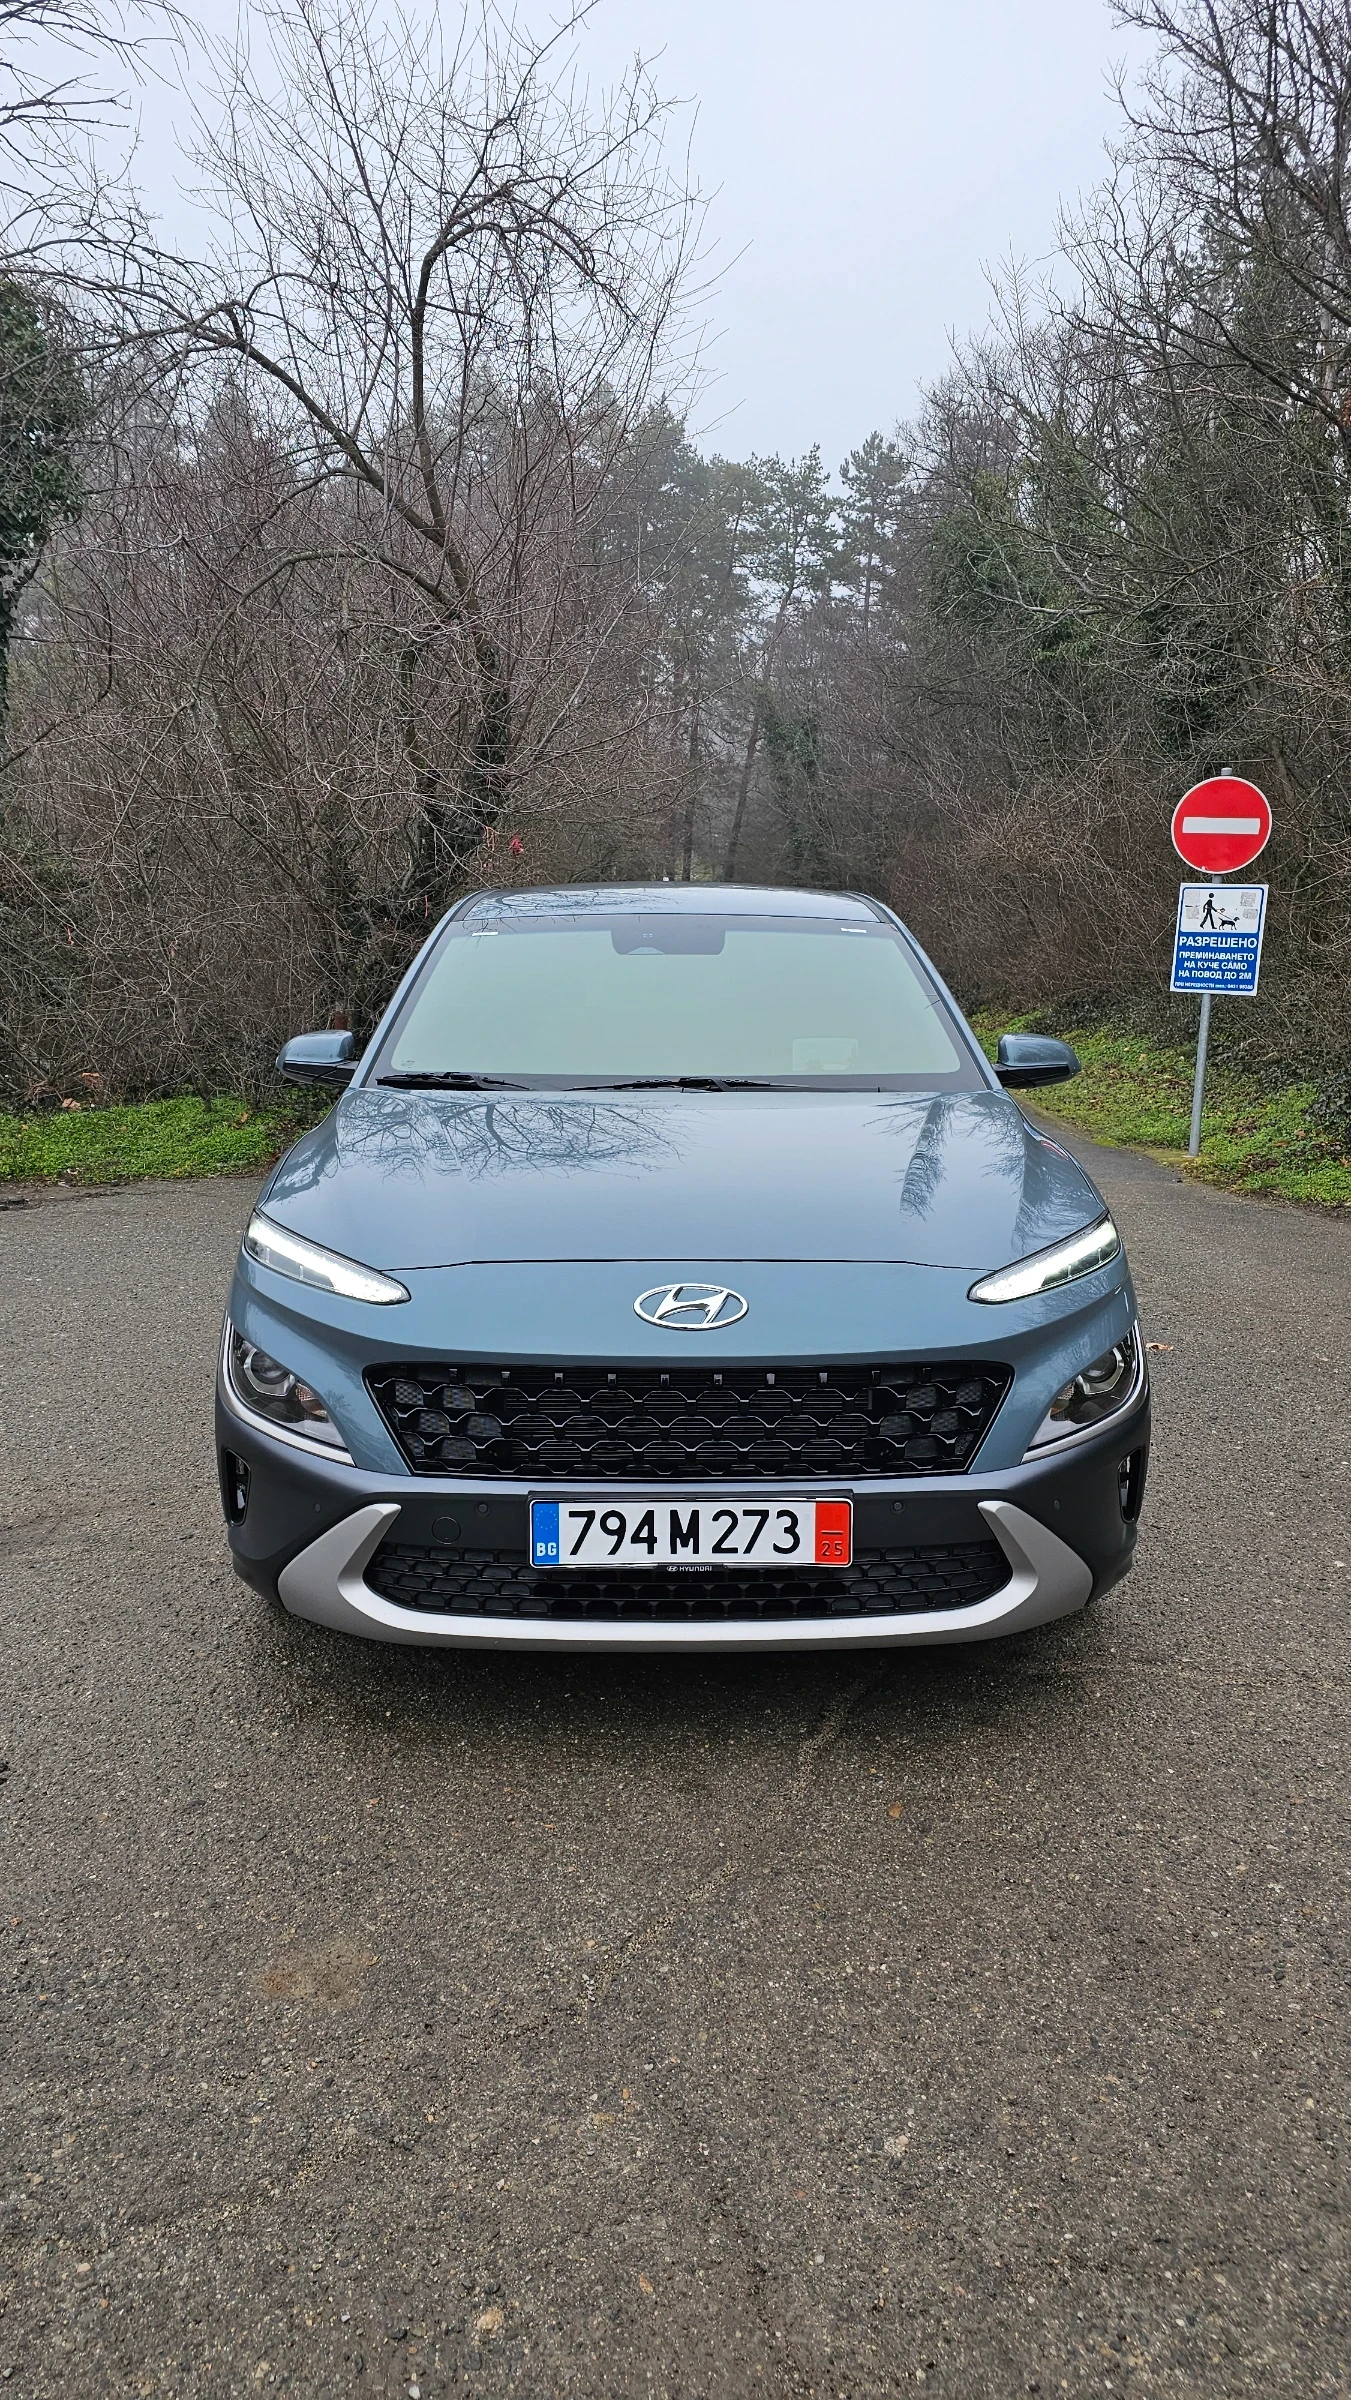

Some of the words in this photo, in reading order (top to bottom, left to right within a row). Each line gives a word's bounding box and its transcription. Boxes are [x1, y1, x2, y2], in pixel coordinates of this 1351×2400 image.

[1179, 936, 1257, 948] РАЗРЕШЕНО
[1179, 951, 1254, 960] ПРЕМИНАВАНЕТО
[1198, 961, 1219, 969] КУЧЕ
[1221, 962, 1247, 970] САМО
[1191, 970, 1222, 979] ПОВОД
[1223, 971, 1237, 980] ДО
[568, 1509, 658, 1555] 794
[669, 1509, 699, 1555] M
[711, 1509, 801, 1554] 273
[536, 1542, 557, 1556] BG
[821, 1540, 843, 1556] 25
